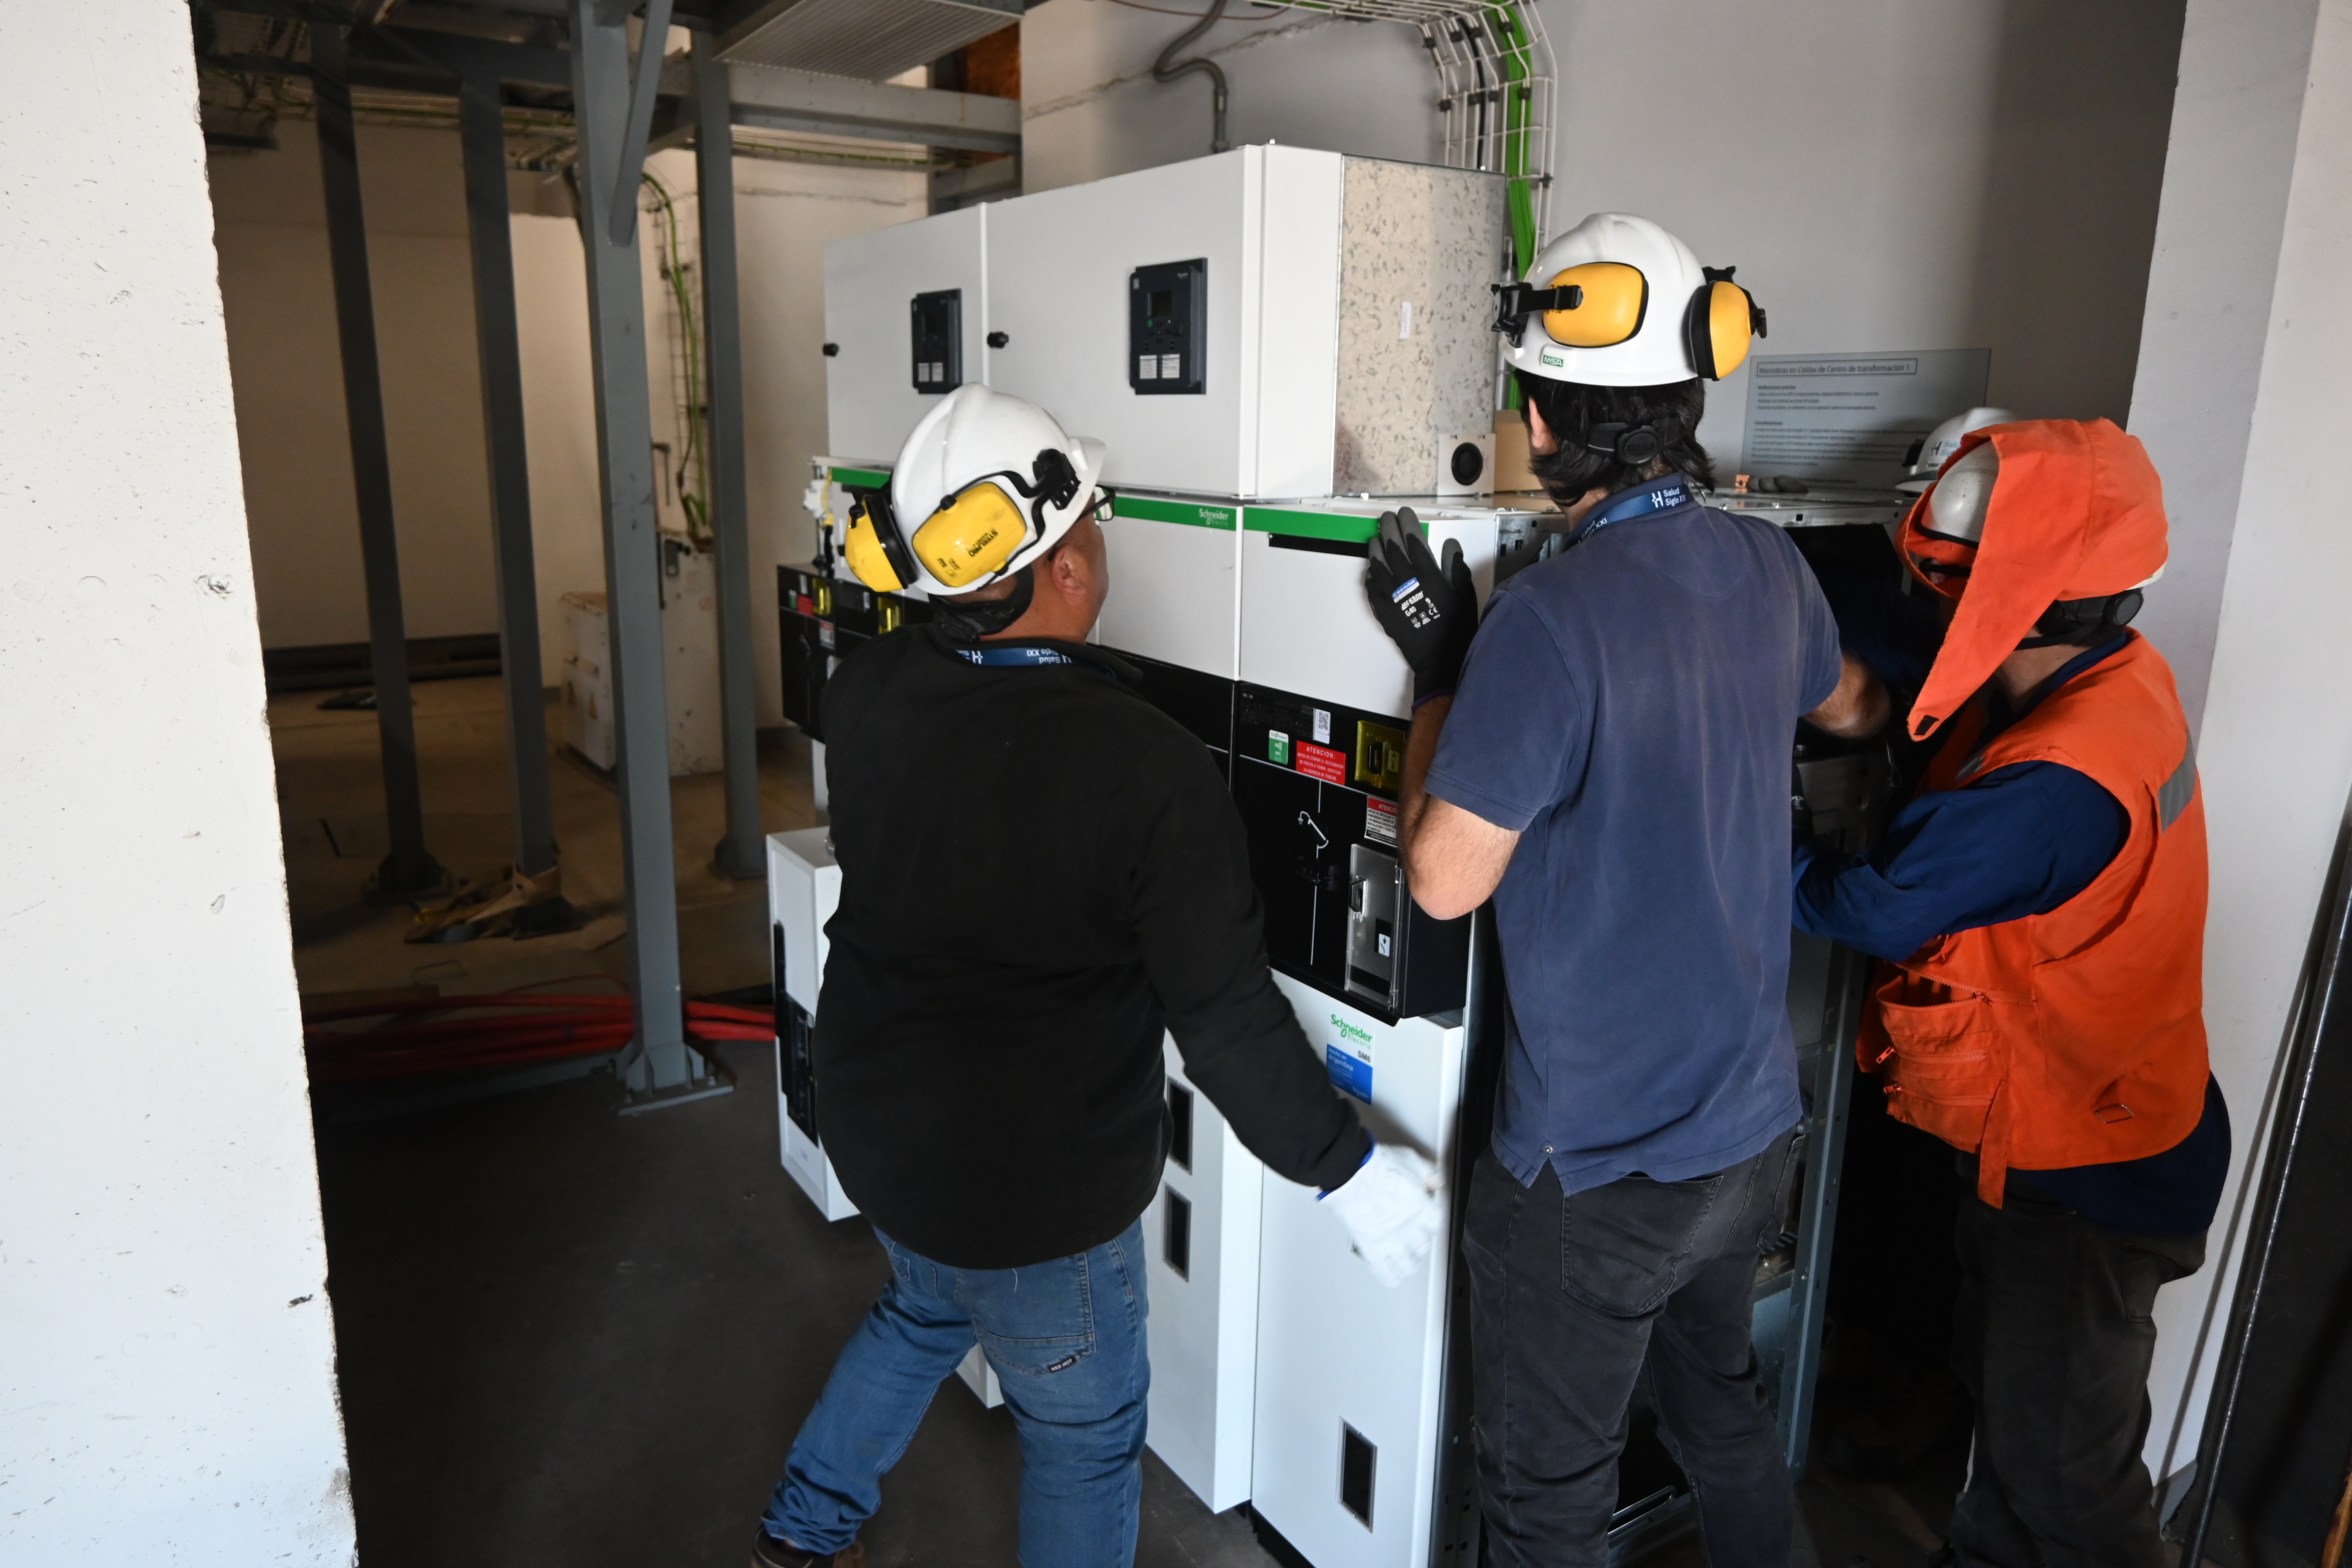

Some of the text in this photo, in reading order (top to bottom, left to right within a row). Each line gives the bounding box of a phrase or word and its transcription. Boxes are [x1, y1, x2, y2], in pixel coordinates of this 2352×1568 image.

[1544, 356, 1562, 367] MSA
[1663, 486, 1680, 497] Salud
[1665, 496, 1679, 506] Siglo
[1199, 508, 1229, 520] Schneider
[1581, 520, 1595, 539] Salud
[1595, 517, 1607, 529] XXI
[968, 530, 998, 557] STEELPRO
[1401, 591, 1424, 611] JACKSON
[1405, 606, 1417, 617] G40
[1039, 656, 1061, 664] Salud
[1306, 746, 1335, 759] ATENCION:
[1331, 1014, 1373, 1042] Schneider
[1348, 1033, 1371, 1050] Electric
[1328, 1054, 1353, 1071] Argentina
[1358, 1050, 1371, 1063] SM6
